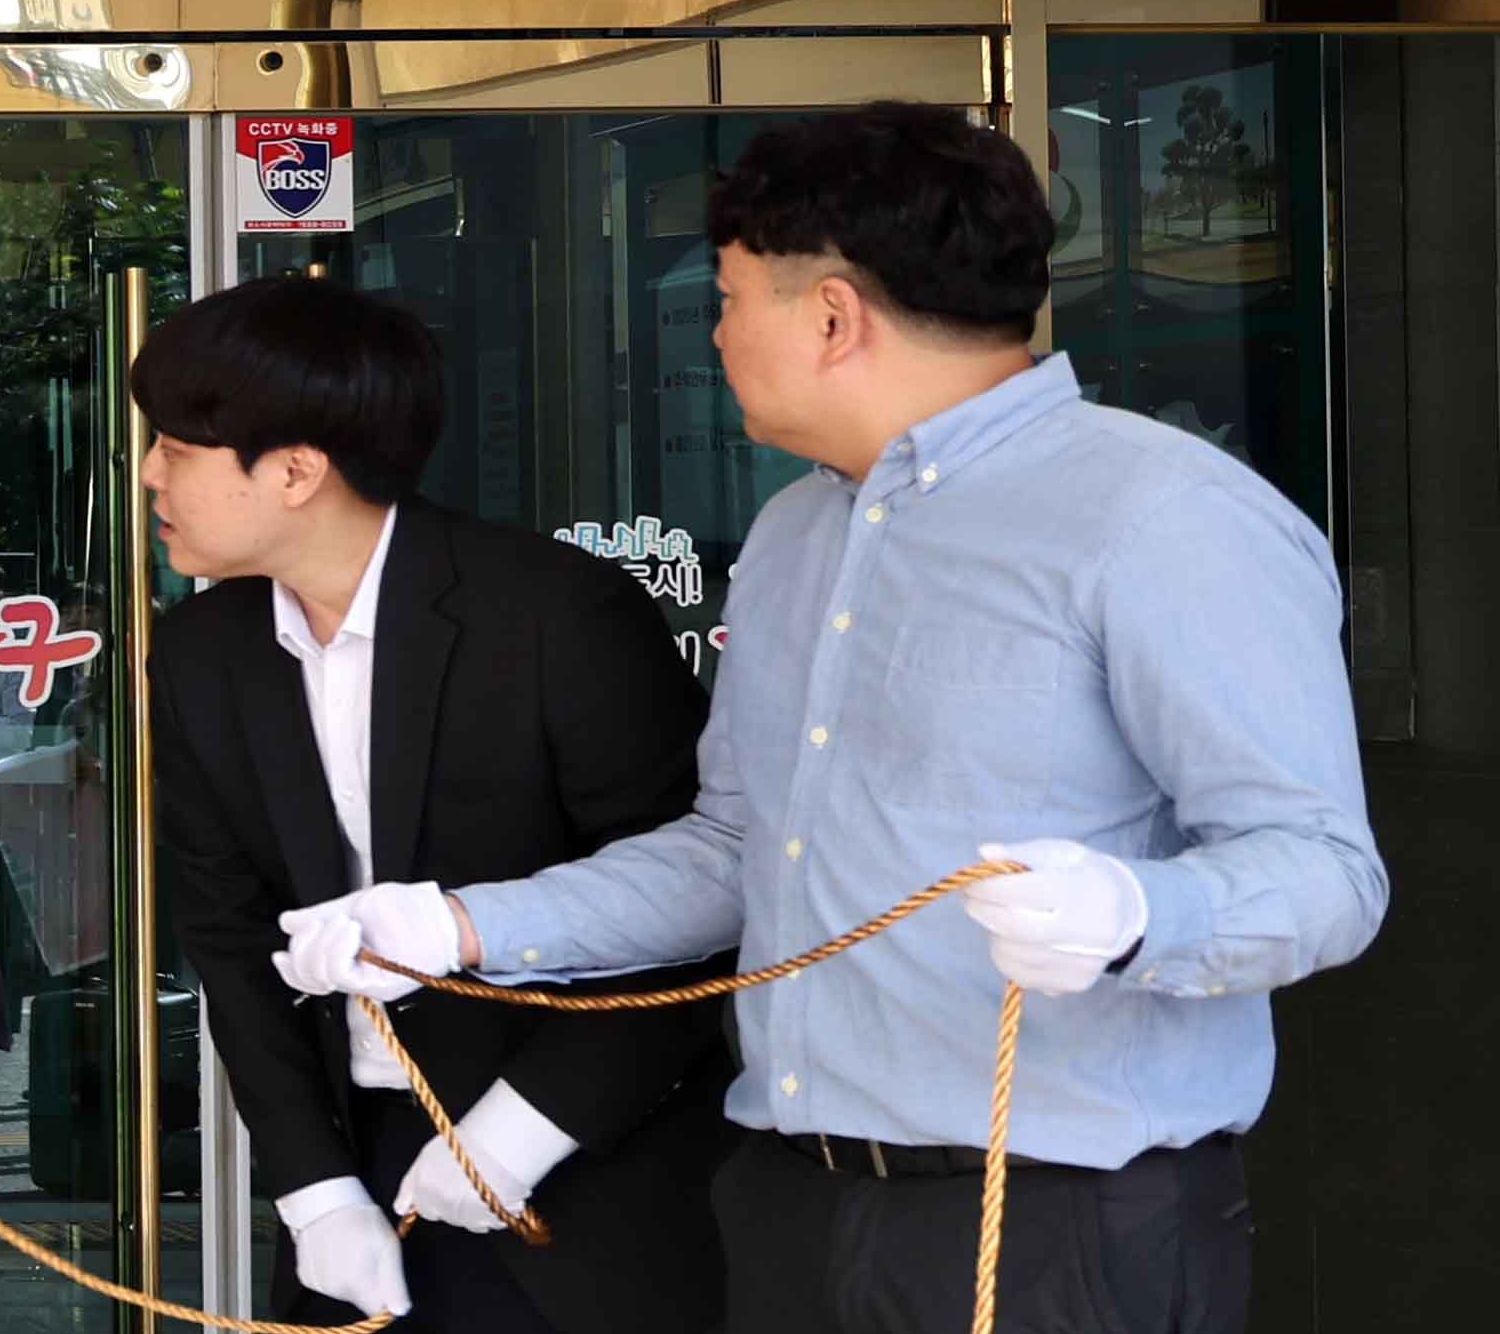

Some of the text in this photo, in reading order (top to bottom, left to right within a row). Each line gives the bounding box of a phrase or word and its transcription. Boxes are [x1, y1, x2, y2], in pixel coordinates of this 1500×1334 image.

[249, 122, 339, 136] CCTV 녹화중
[266, 170, 326, 191] BOSS
